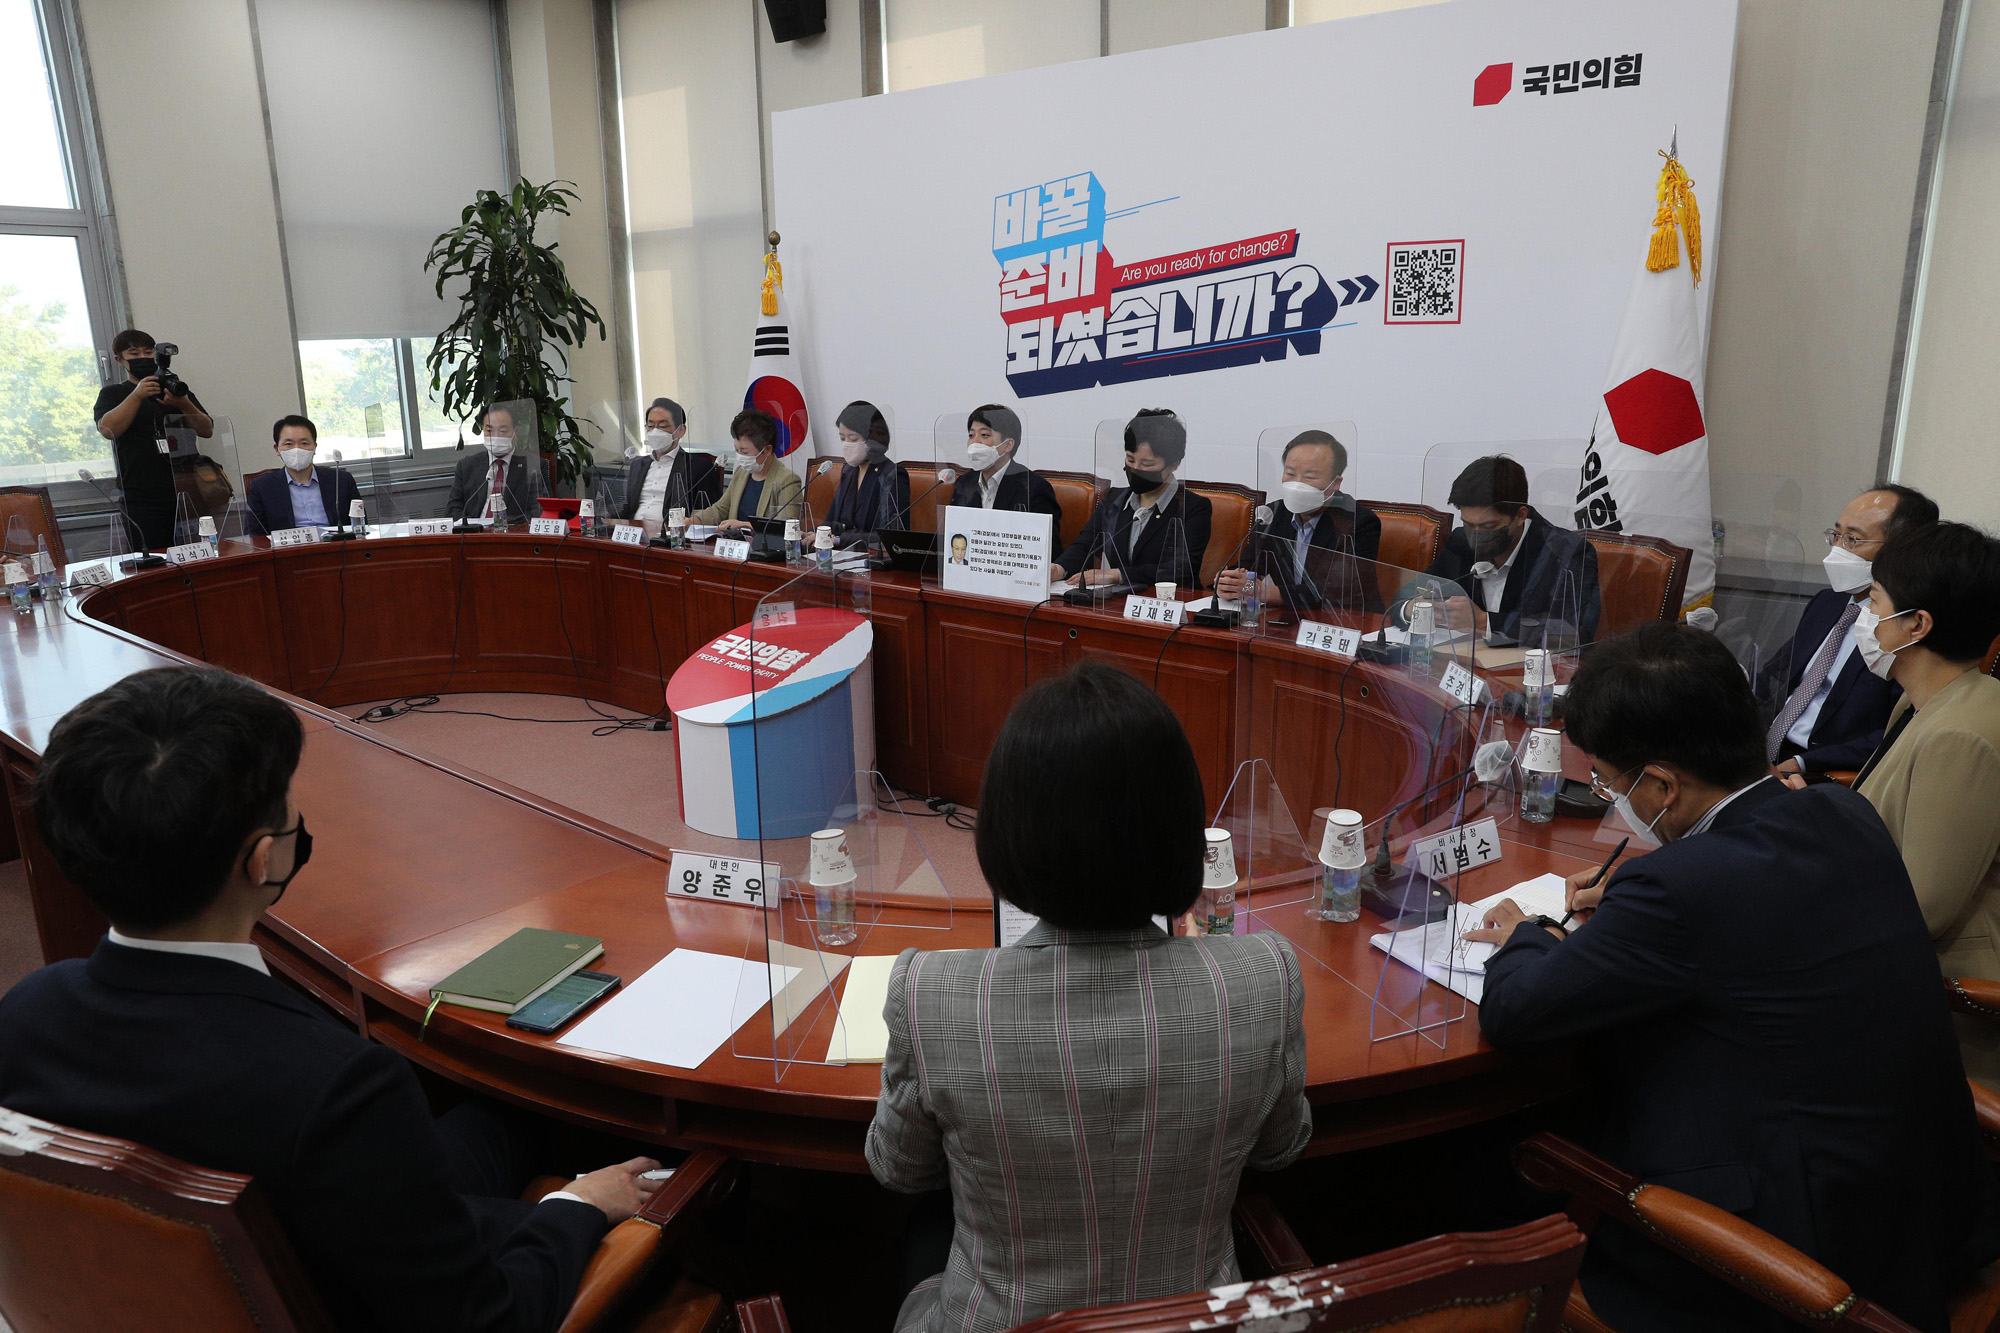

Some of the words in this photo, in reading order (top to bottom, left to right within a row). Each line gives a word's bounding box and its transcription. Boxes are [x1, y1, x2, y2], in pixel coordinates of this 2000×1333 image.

[1522, 53, 1643, 96] 국민의힘
[994, 171, 1095, 250] 바꿀
[1121, 265, 1143, 283] Are
[1145, 263, 1168, 280] you
[1170, 250, 1206, 274] ready
[1208, 247, 1227, 266] for
[1229, 233, 1289, 262] change?
[1000, 238, 1100, 313] 준비
[1005, 263, 1322, 375] 되셨습니까?
[280, 533, 314, 545] 성일종
[414, 524, 448, 534] 한기호
[534, 524, 560, 533] 김도읍
[176, 548, 210, 562] 김석기
[1131, 604, 1174, 622] 김재원
[1141, 598, 1168, 608] 최고위원
[1316, 625, 1344, 636] 최고위원
[1305, 631, 1351, 652] 김용태
[696, 652, 726, 665] PEOPLE
[724, 660, 752, 673] POWER
[710, 633, 811, 672] 국민의힘
[1437, 827, 1476, 847] 비서실장
[709, 859, 740, 873] 대변인
[1432, 838, 1492, 876] 서범수
[682, 869, 762, 902] 양준우
